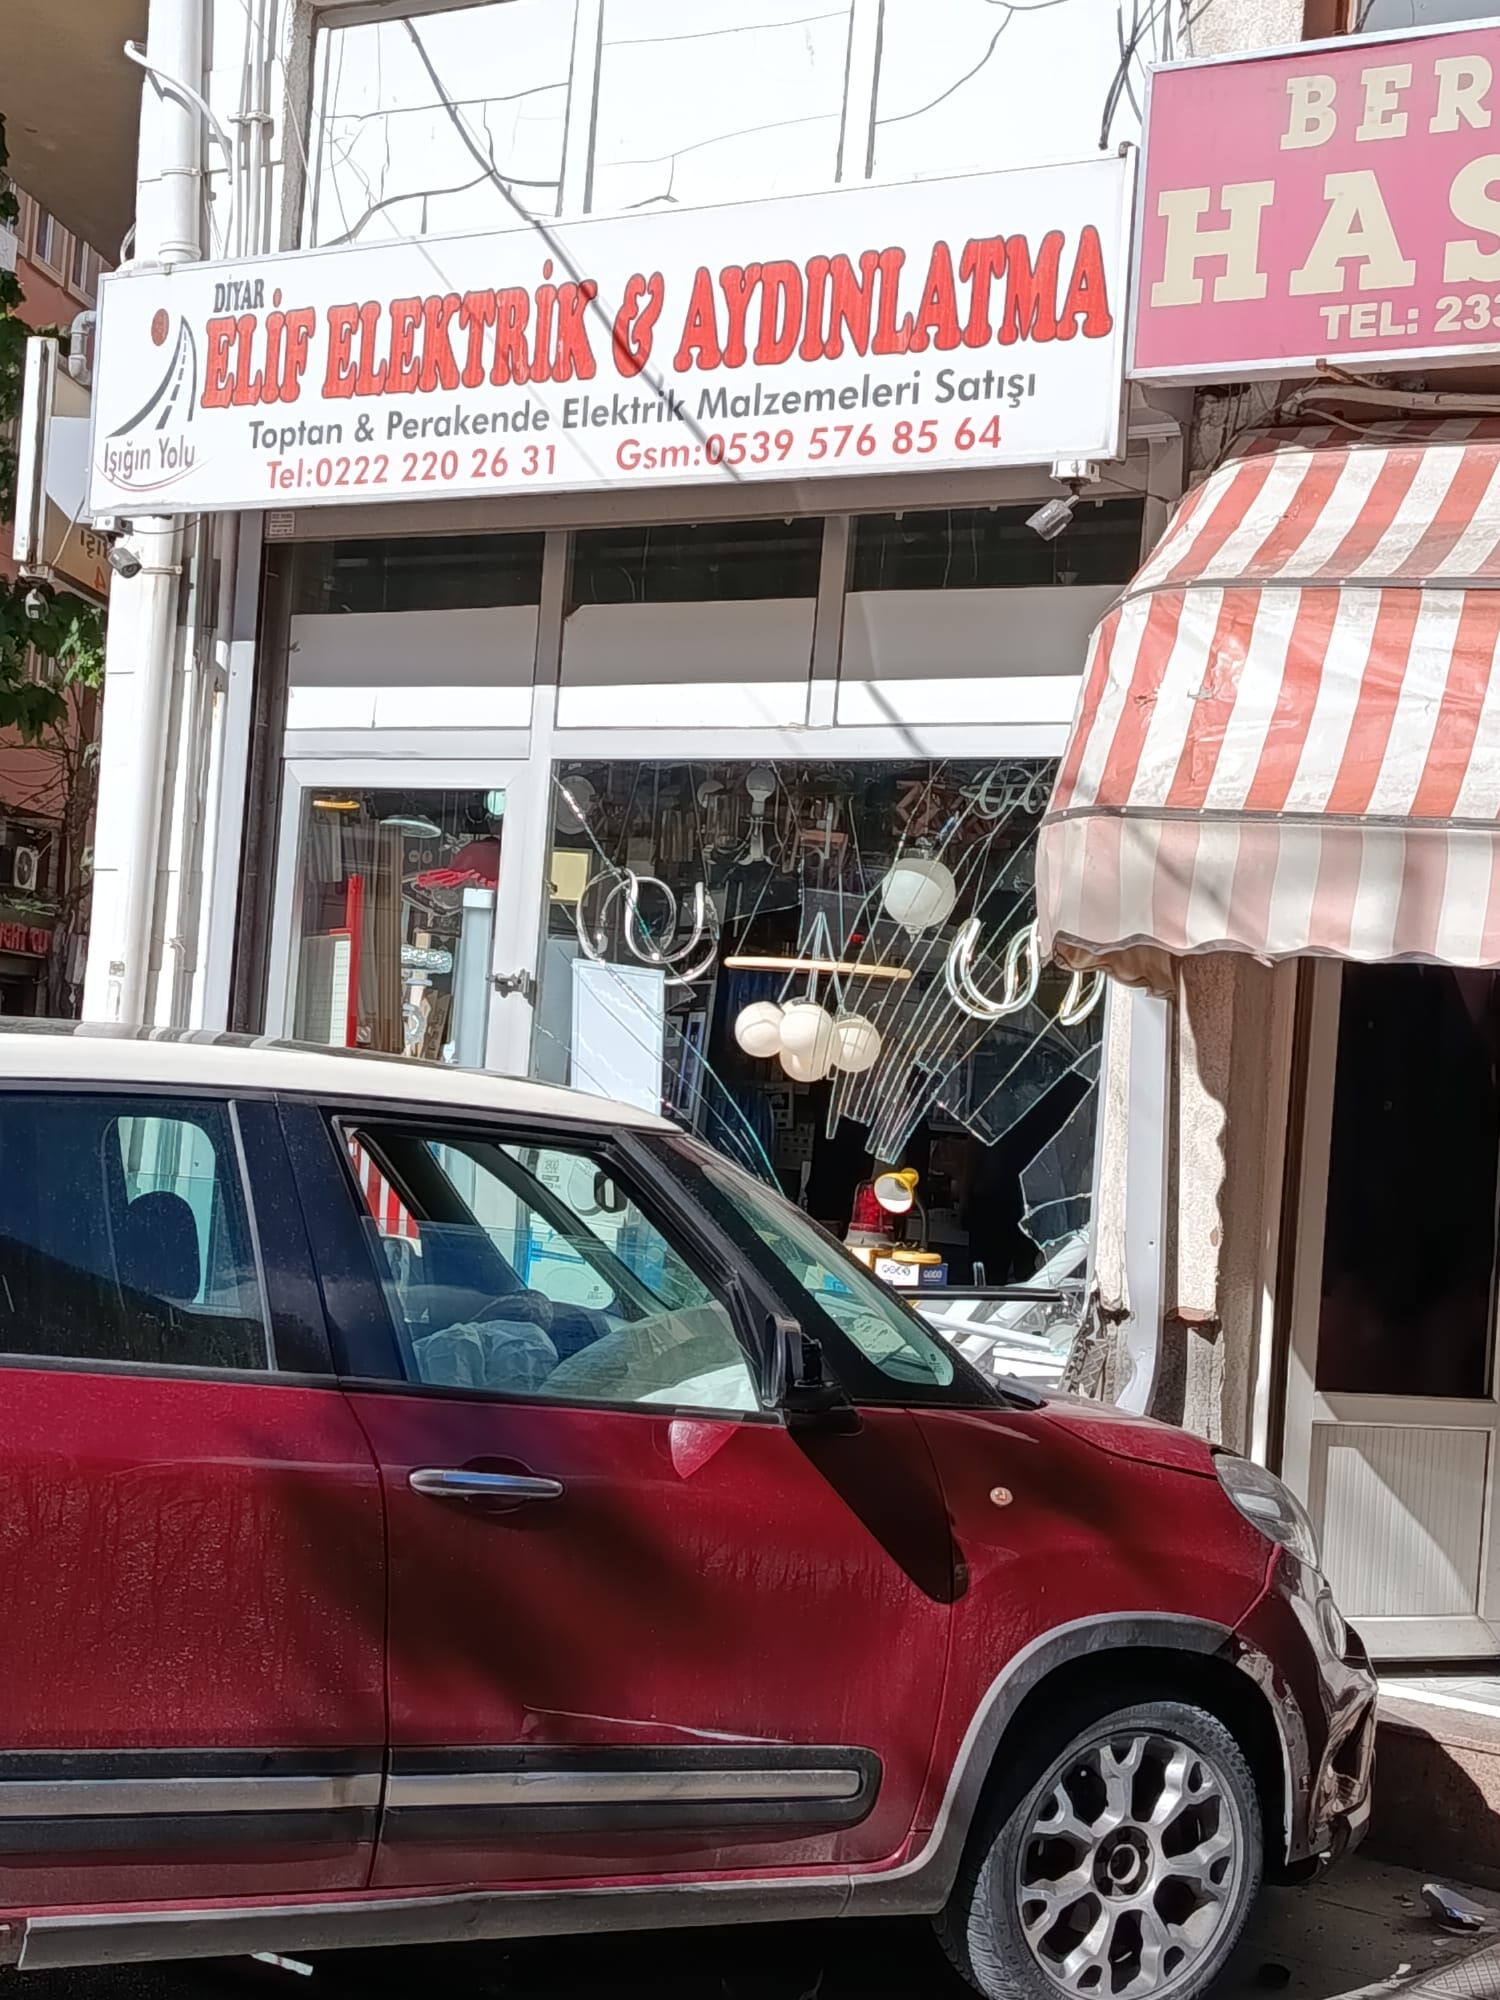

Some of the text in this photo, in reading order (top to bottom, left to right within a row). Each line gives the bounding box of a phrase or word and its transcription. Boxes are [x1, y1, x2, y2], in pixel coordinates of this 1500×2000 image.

[1279, 54, 1493, 151] BER
[200, 225, 1113, 409] ELİF ELEKTRİK & AYDINLATMA
[213, 274, 264, 313] DİYAR
[1319, 301, 1420, 340] TEL:
[249, 369, 1037, 455] Toptan & Perakende Elektrik Malzemeleri Satışı
[104, 434, 195, 482] Işığın Yolu
[266, 444, 557, 490] Tel:0222 220 26 31
[616, 415, 1002, 472] Gsm:0539 576 85 64
